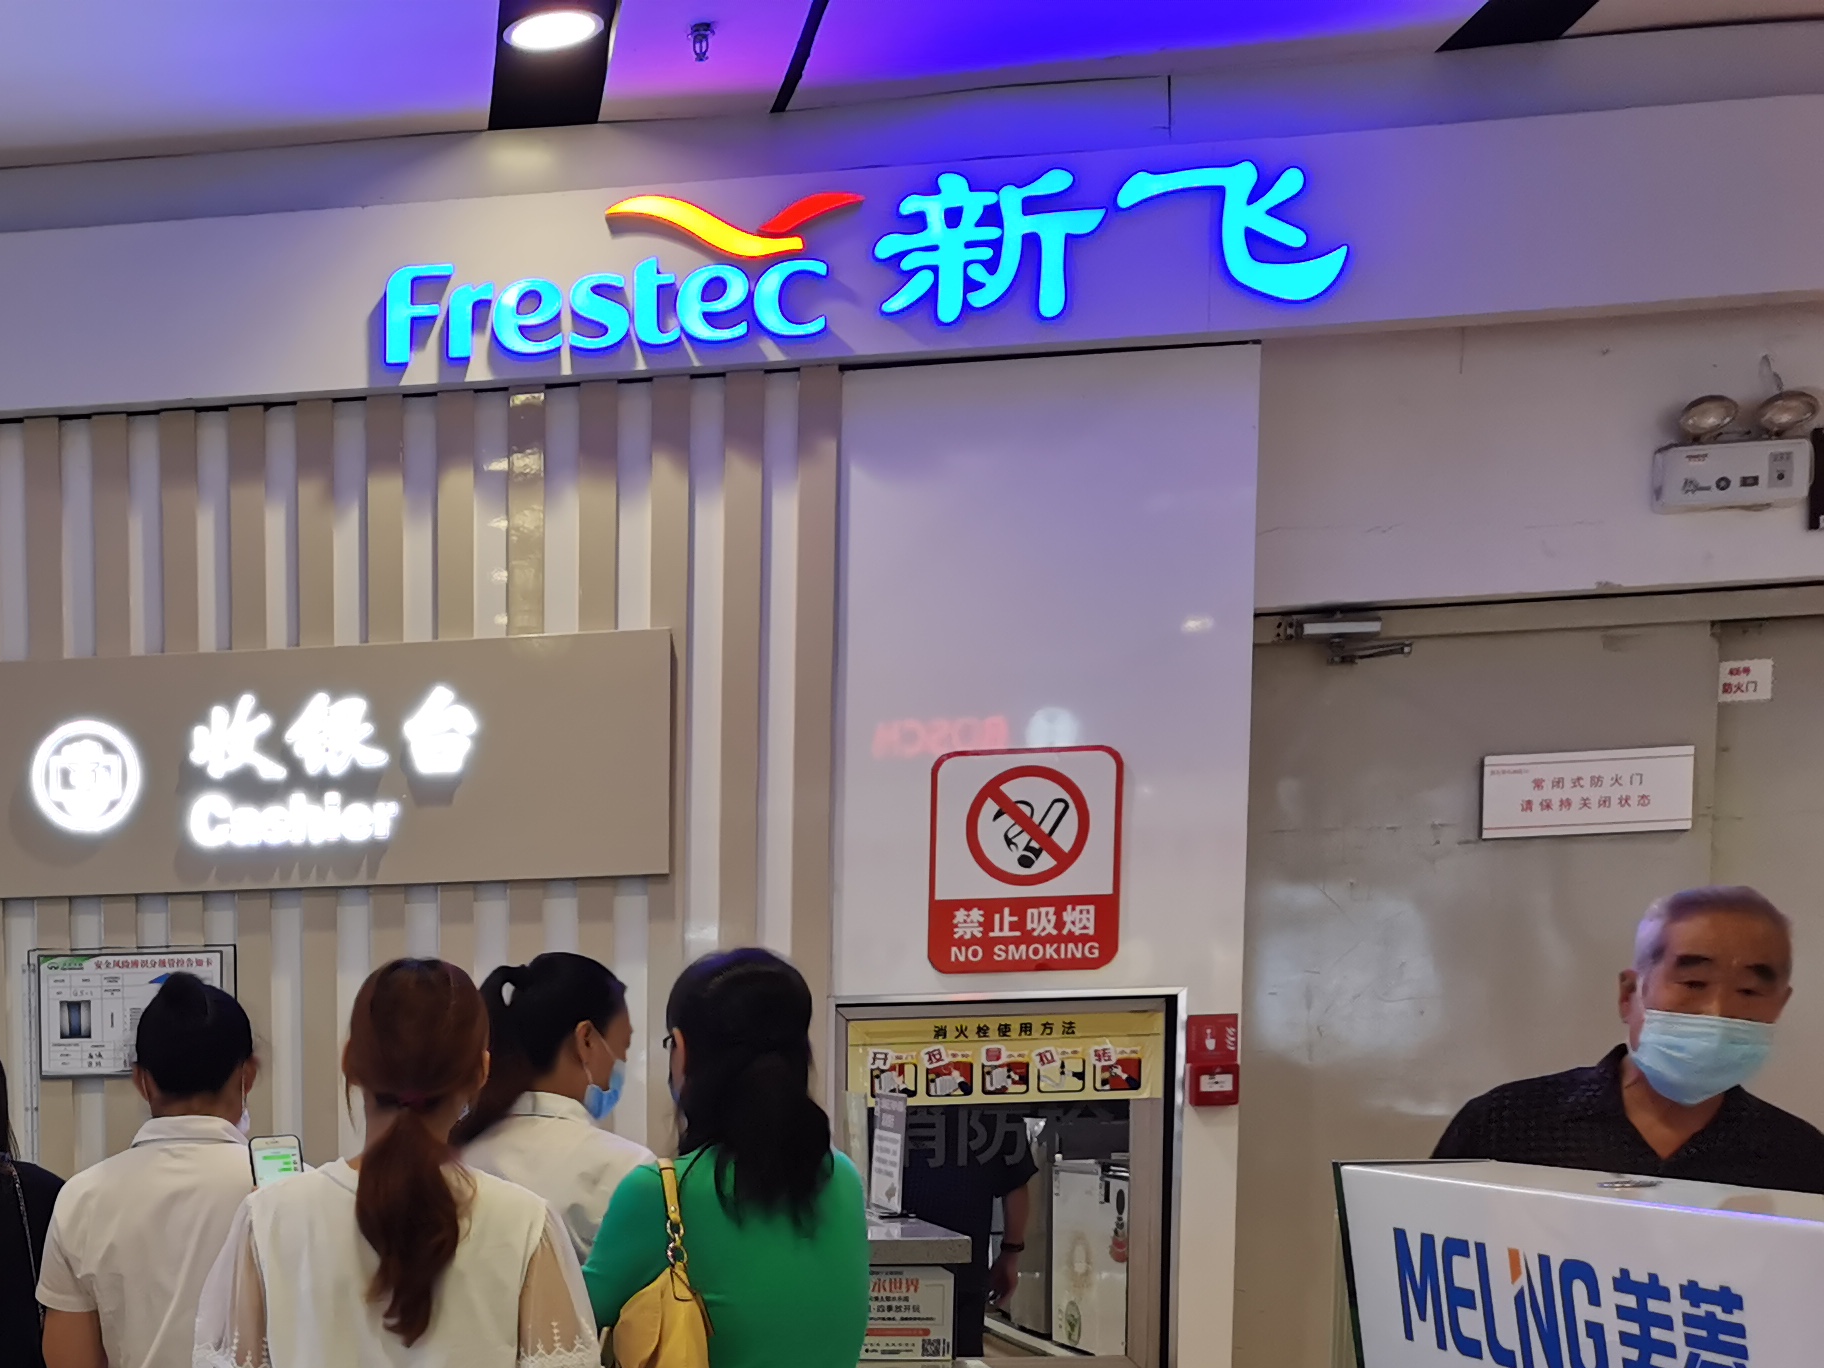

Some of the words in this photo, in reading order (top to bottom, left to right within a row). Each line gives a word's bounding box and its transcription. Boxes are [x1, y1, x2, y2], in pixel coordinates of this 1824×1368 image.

[383, 256, 829, 367] Frestec
[873, 161, 1351, 323] 新飞
[188, 684, 480, 781] 收银台
[1531, 773, 1643, 791] 常闭式防火门
[1520, 794, 1651, 813] 请保持关闭状态
[188, 791, 398, 847] Cashier
[951, 904, 1096, 939] 禁止吸烟
[950, 945, 983, 963] NO
[992, 941, 1100, 962] SMOKING
[932, 1020, 1077, 1040] 消火栓使用方法
